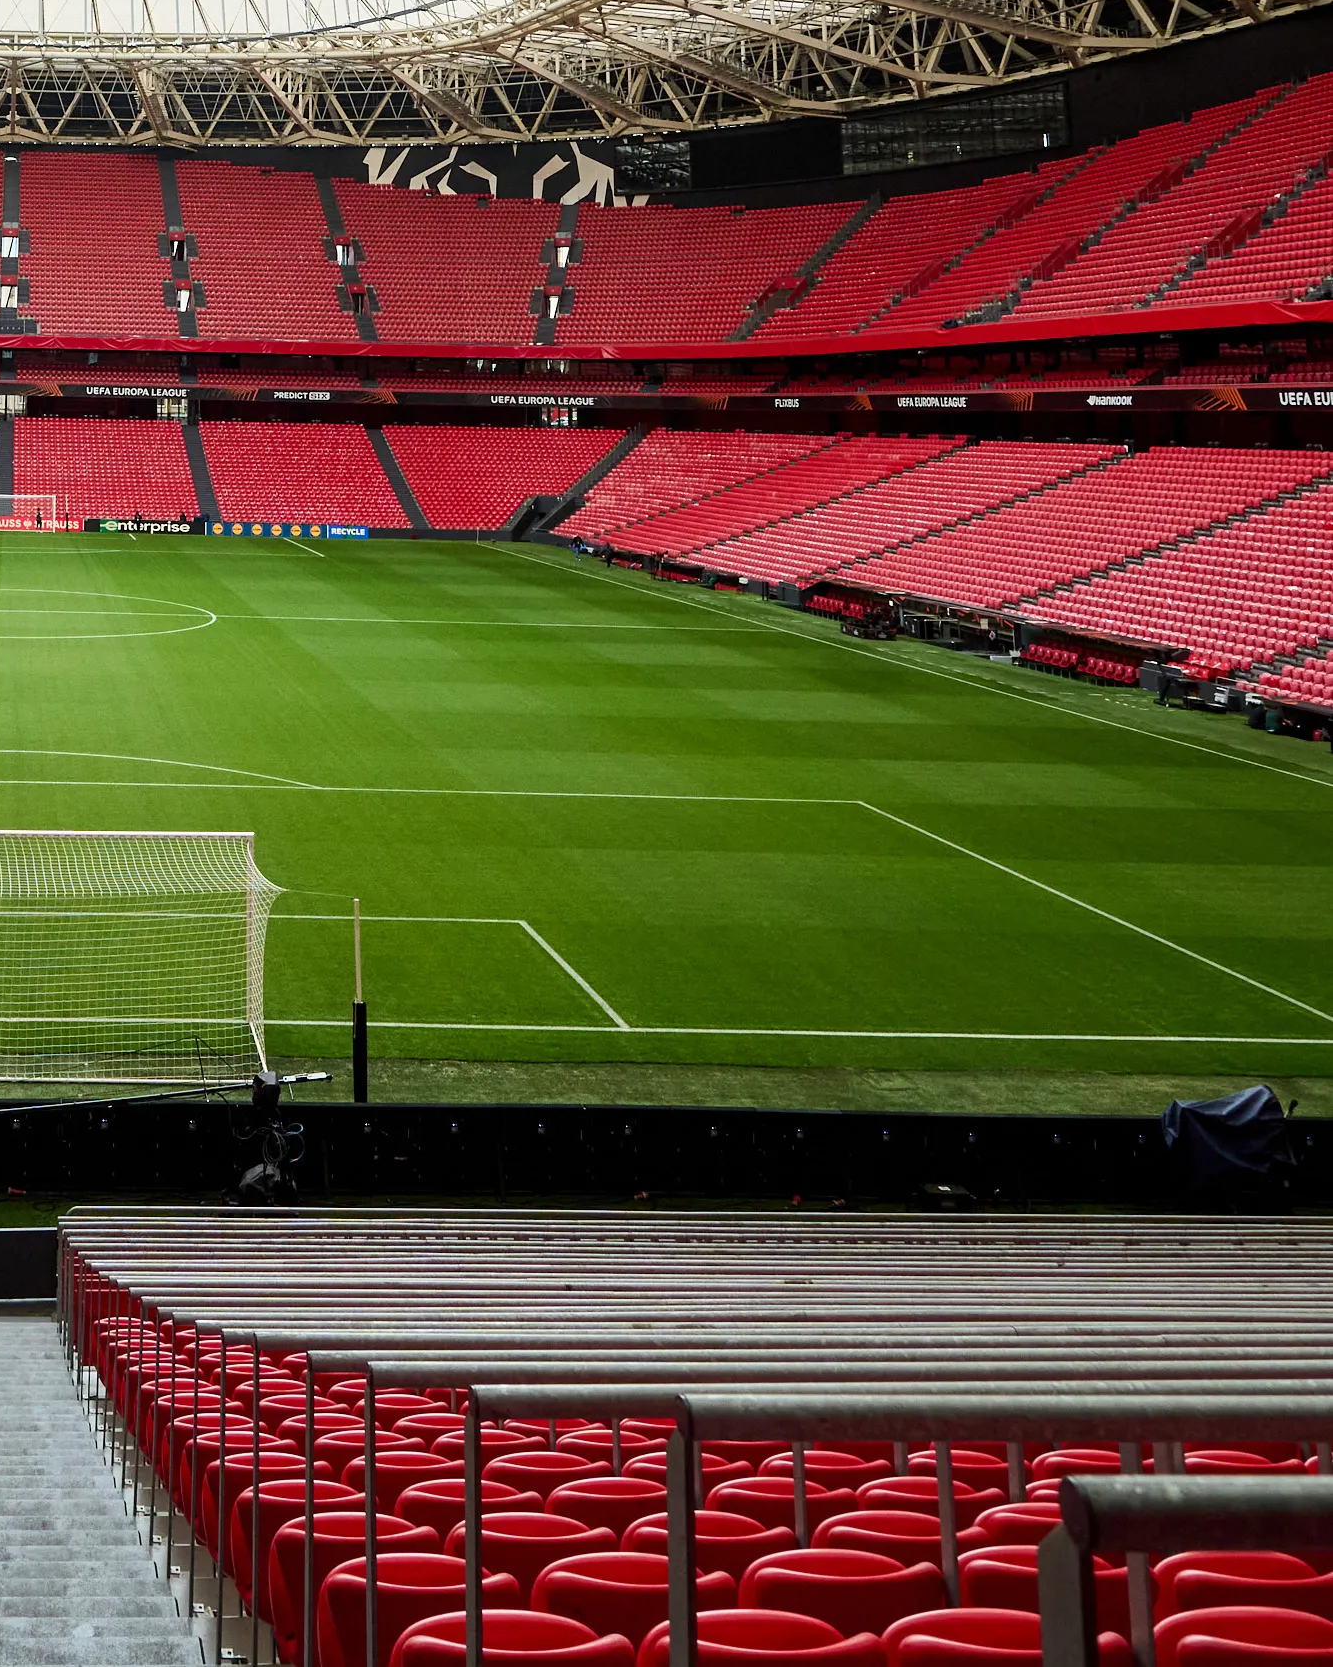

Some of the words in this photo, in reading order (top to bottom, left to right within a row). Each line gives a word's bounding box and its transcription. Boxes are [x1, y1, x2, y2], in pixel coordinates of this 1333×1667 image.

[86, 386, 111, 396] UEFA
[112, 386, 149, 397] EUROPA
[273, 391, 309, 400] PREDICT
[490, 395, 516, 405] UEFA
[517, 396, 556, 405] EUROPA
[897, 397, 914, 407] UEFA
[914, 397, 940, 408] EUROPA
[1279, 391, 1313, 406] UEFA
[331, 527, 366, 536] RECYCLE
